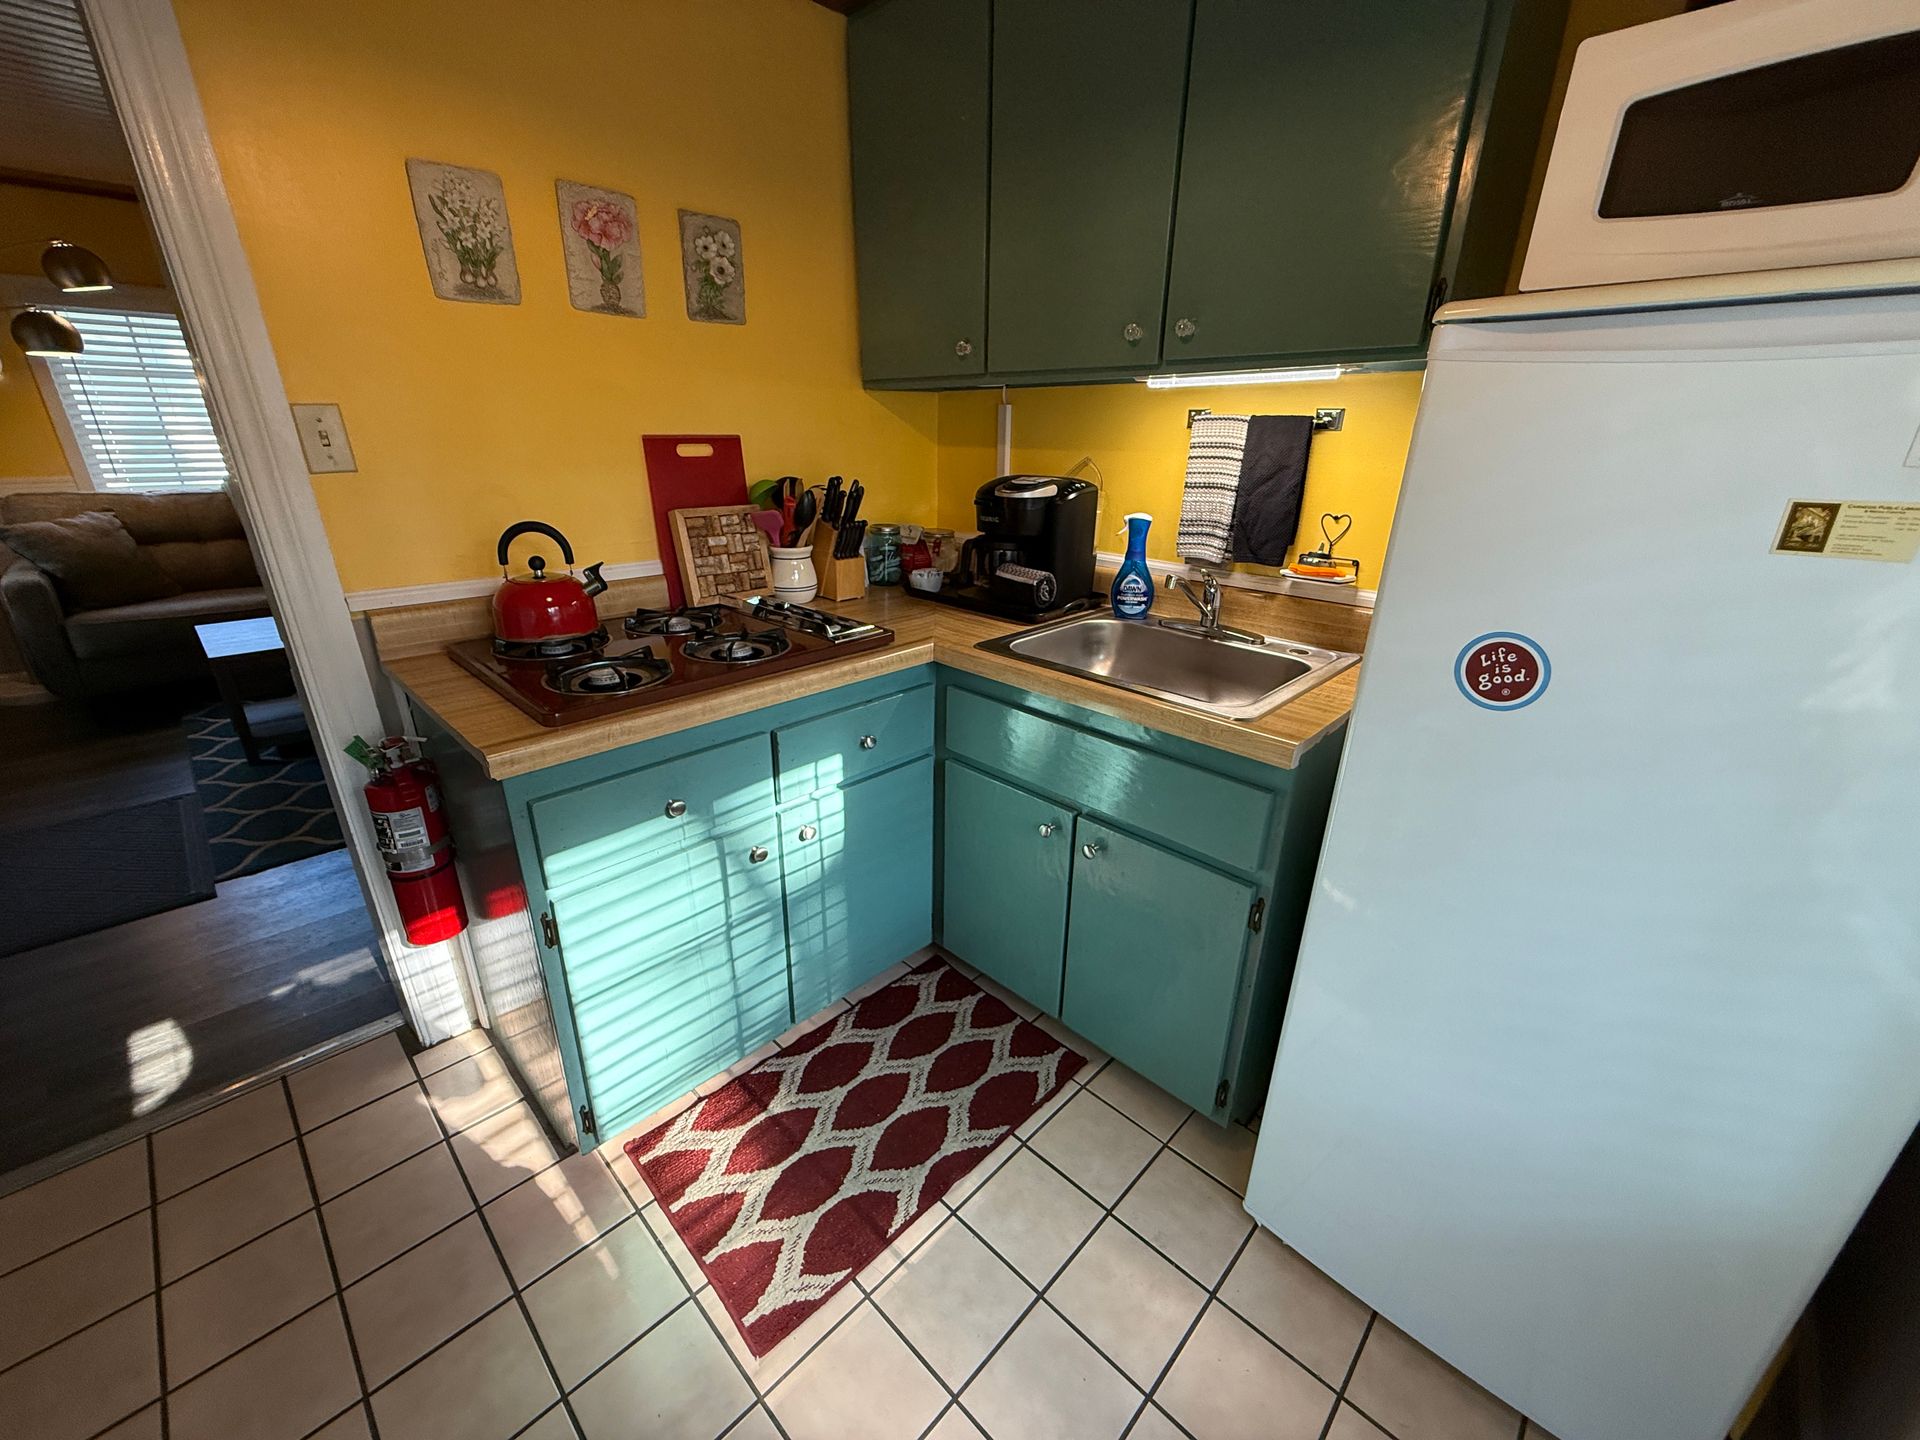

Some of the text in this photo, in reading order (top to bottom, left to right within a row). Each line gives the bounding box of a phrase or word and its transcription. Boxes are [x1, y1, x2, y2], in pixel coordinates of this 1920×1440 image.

[1480, 647, 1518, 667] Life
[1495, 663, 1511, 674] is
[1478, 668, 1530, 691] good.
